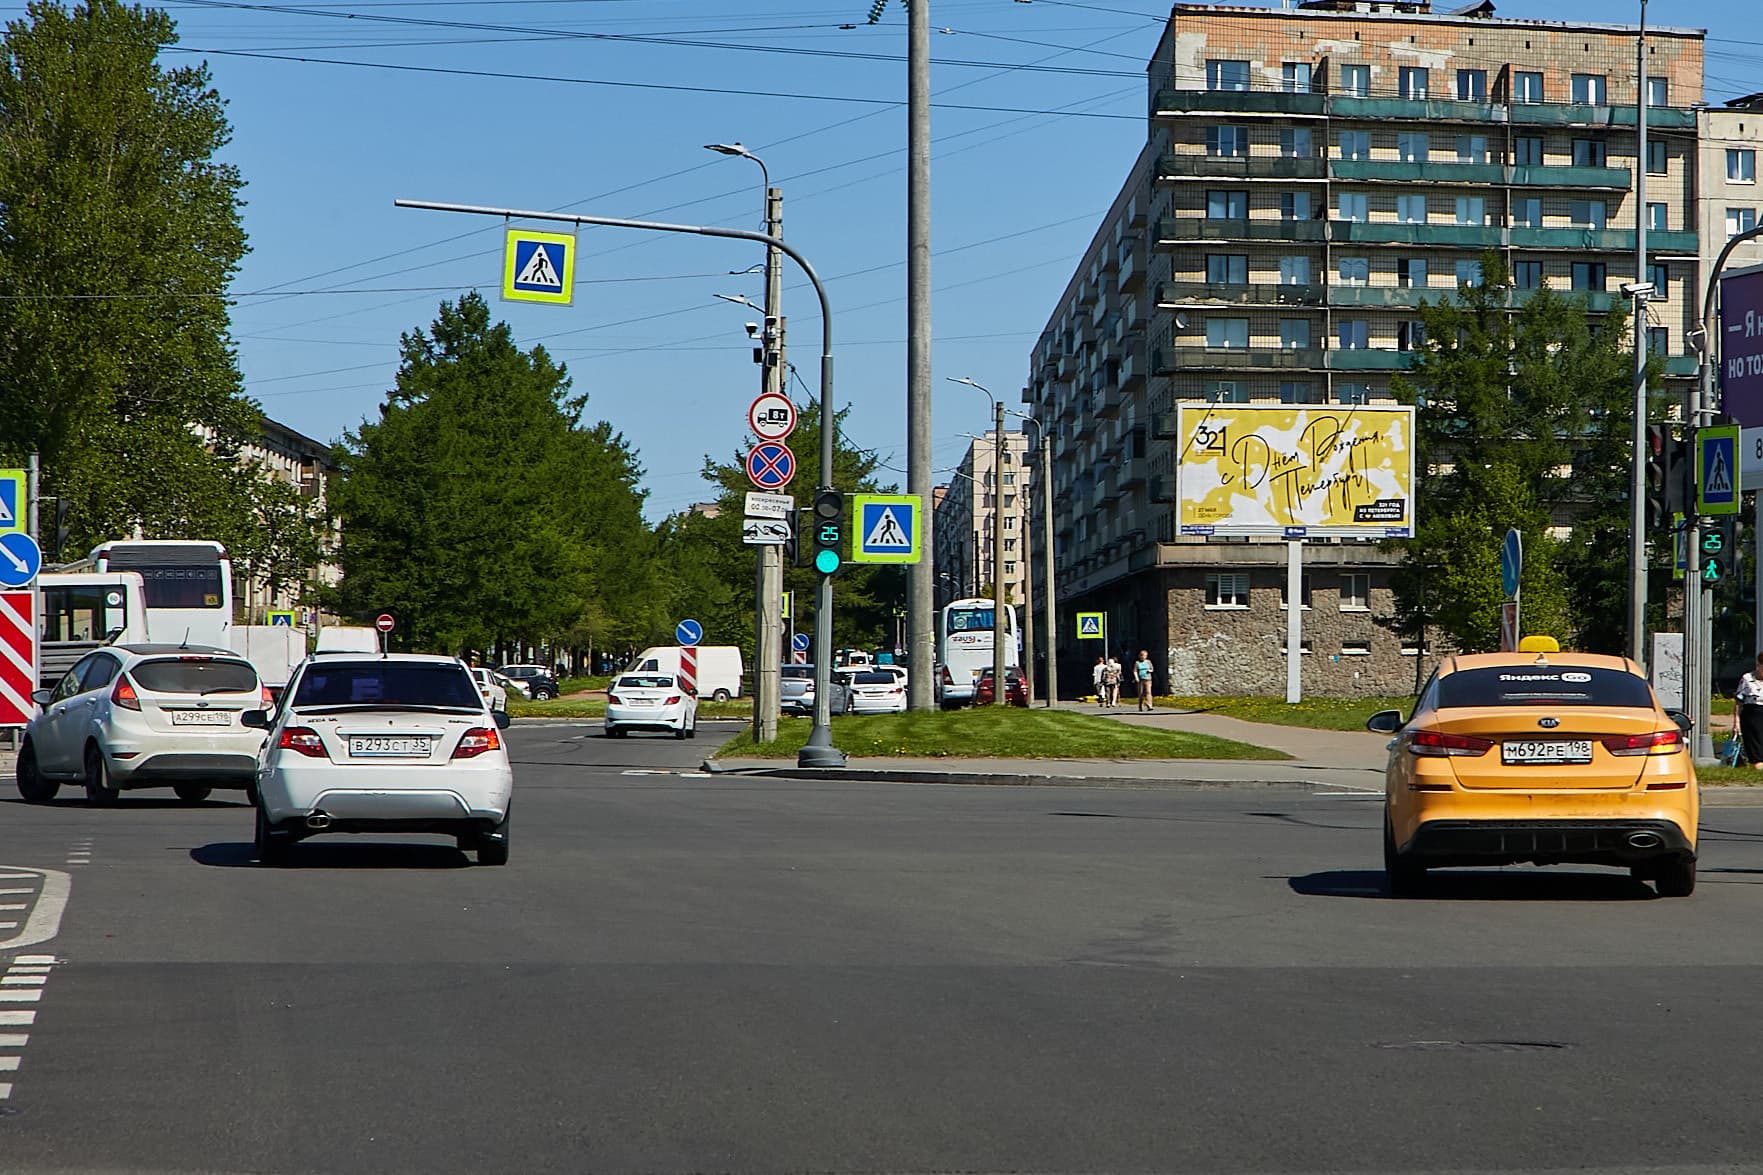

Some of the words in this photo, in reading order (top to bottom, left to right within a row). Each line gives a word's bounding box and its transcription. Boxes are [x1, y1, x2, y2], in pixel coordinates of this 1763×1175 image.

[1745, 310, 1755, 338] Я
[1746, 354, 1763, 377] то
[1196, 425, 1226, 457] 321
[820, 526, 839, 540] 25
[1499, 674, 1560, 682] Яндекс
[1540, 719, 1556, 727] KIA
